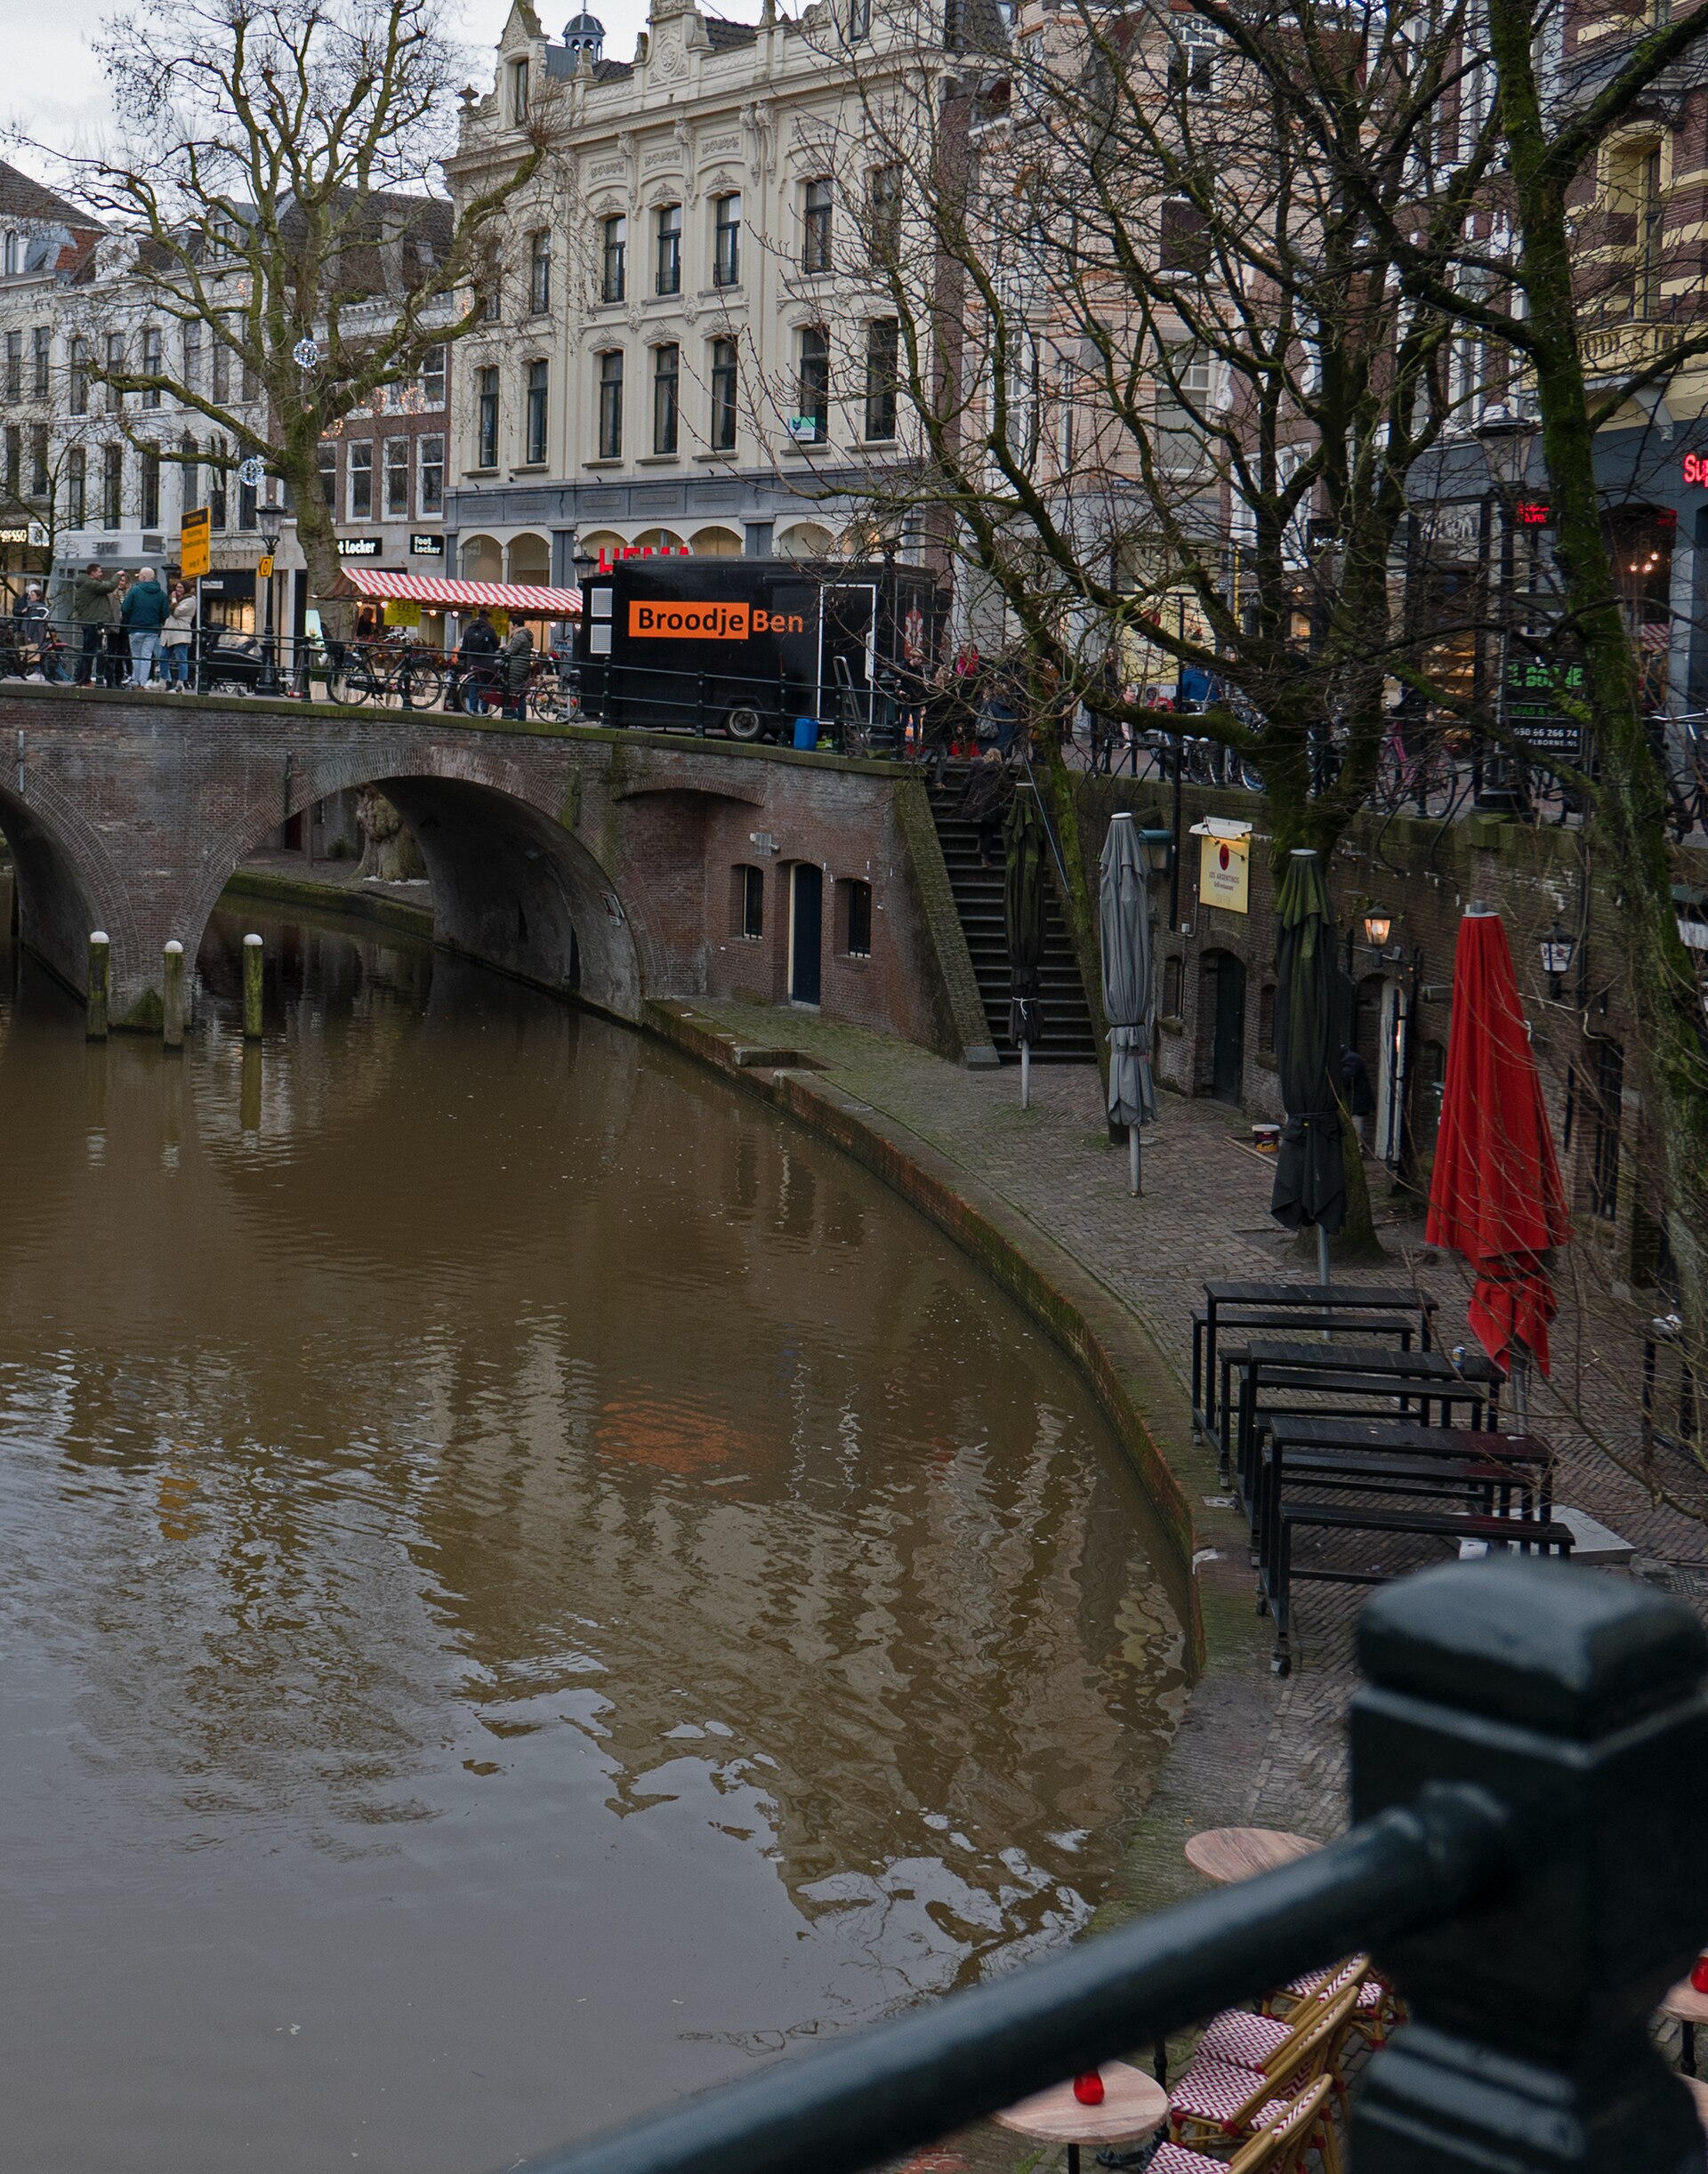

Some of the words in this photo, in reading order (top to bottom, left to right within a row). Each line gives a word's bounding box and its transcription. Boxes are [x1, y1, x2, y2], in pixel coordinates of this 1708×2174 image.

[414, 535, 432, 545] Foot
[345, 540, 375, 554] Locker
[414, 544, 441, 554] Locker
[639, 608, 744, 636] Broodje
[753, 609, 803, 633] Ben
